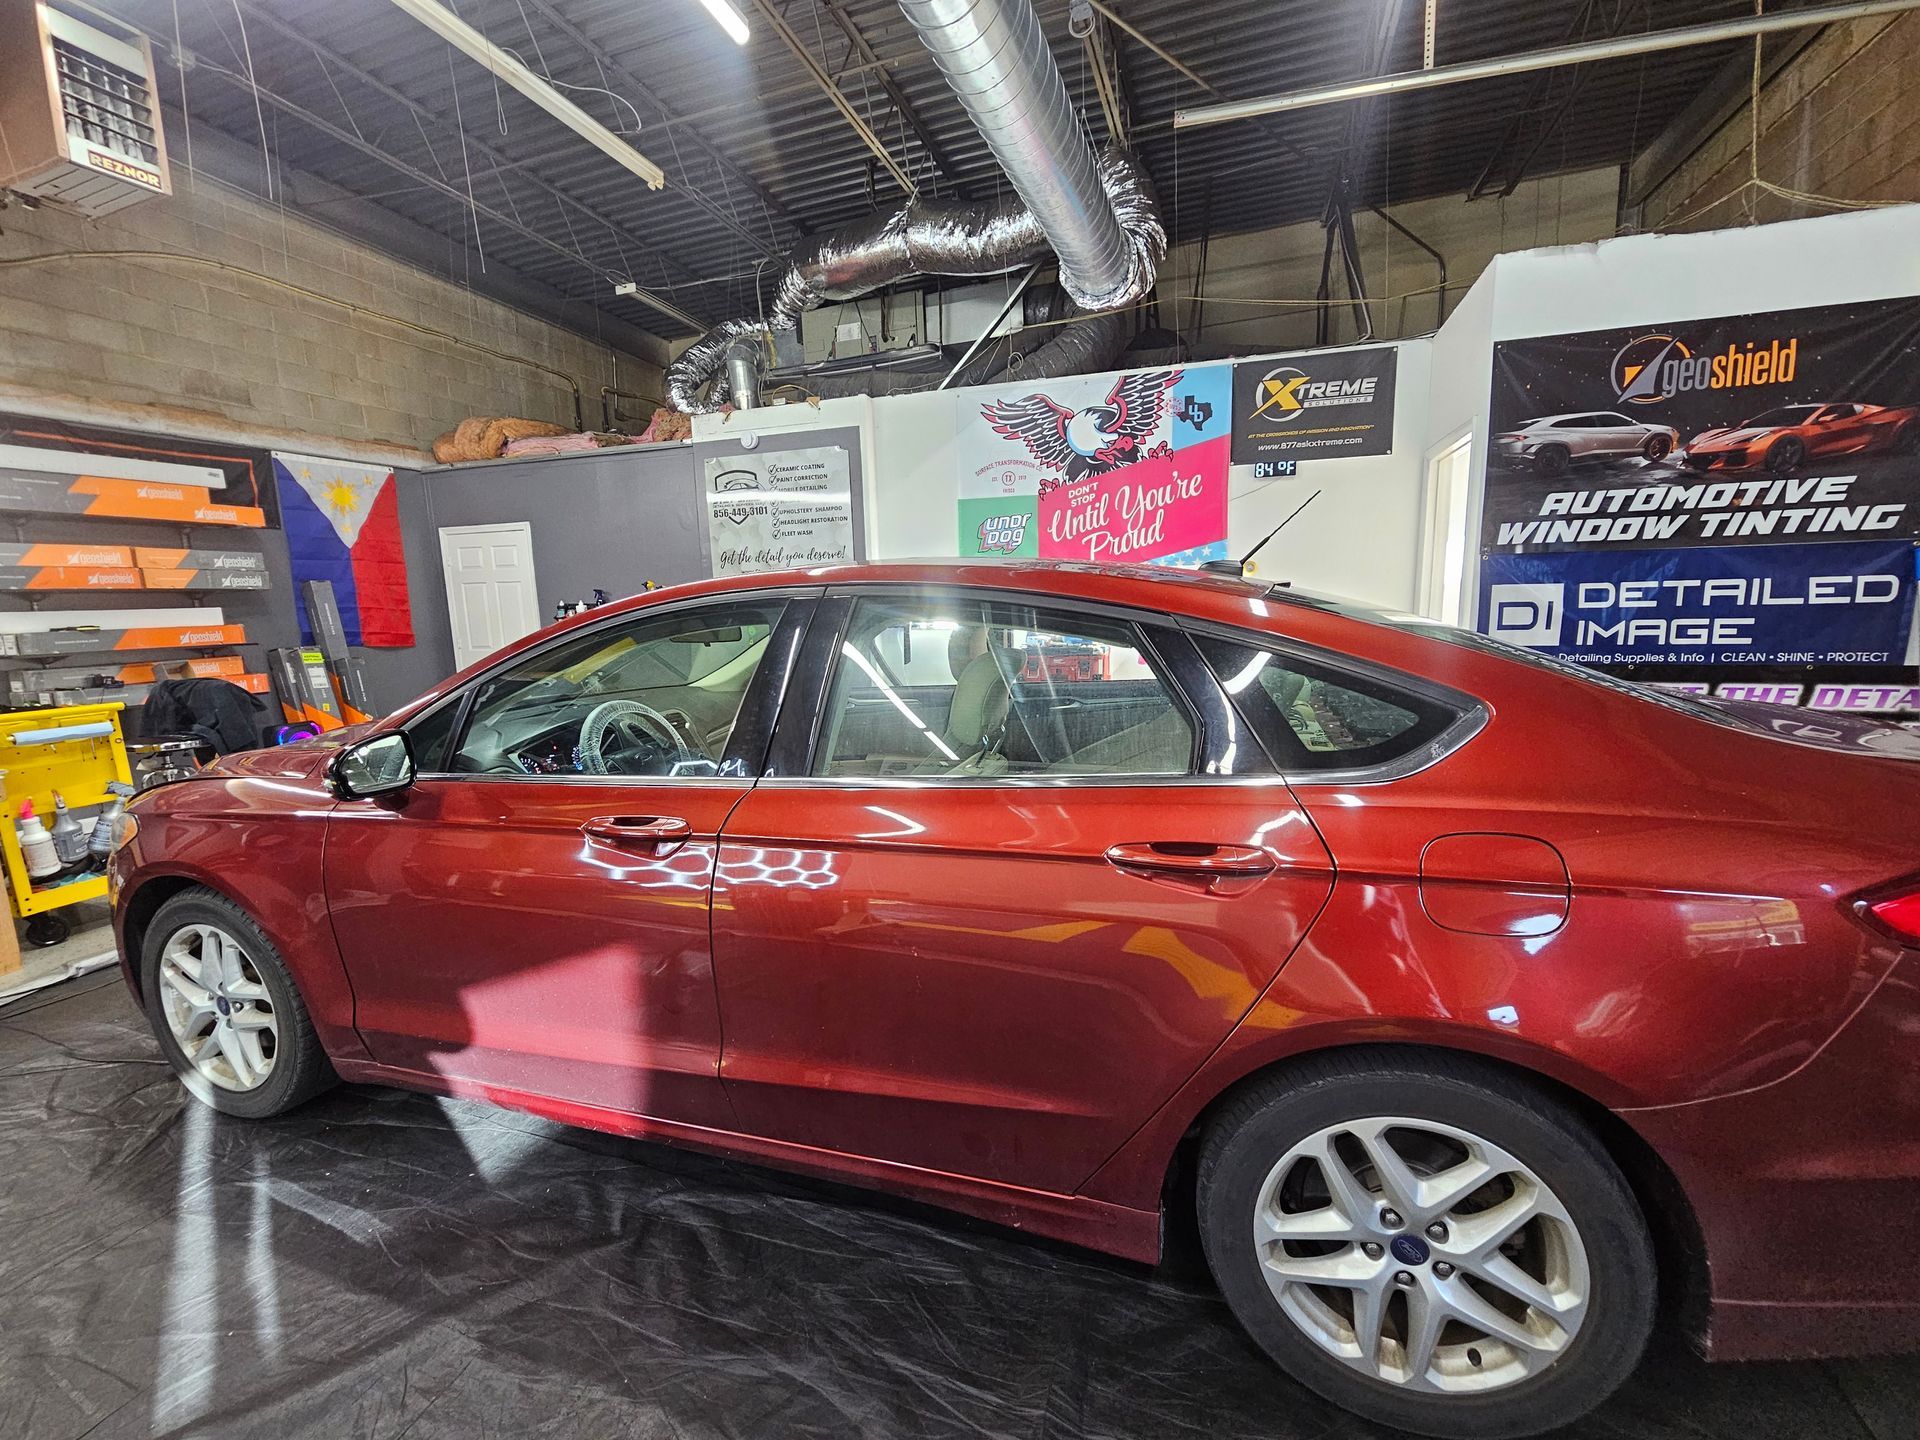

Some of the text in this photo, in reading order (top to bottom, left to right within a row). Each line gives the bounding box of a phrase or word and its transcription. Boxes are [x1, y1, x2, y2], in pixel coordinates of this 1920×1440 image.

[90, 152, 160, 186] REZNOR
[1661, 338, 1797, 398] geoshield
[1249, 376, 1378, 420] XTREME
[1308, 397, 1368, 406] SOLUTIONS
[775, 463, 825, 473] CERAMIC COATING
[975, 462, 994, 477] SURFACE
[994, 460, 1035, 469] TRANSFORMATION
[1255, 463, 1273, 477] 84
[1068, 482, 1099, 499] DON'T
[1071, 494, 1096, 507] STOP
[1538, 475, 1857, 516] AUTOMOTIVE
[713, 506, 768, 518] 856-449-3101
[779, 507, 812, 515] UPHOLSTERY
[1048, 471, 1203, 542] Until You're
[1082, 509, 1164, 560] Proud
[1496, 503, 1906, 545] WINDOW TINTING
[720, 545, 846, 569] Get the detail you deserve!
[1578, 574, 1899, 609] DETAILED
[1496, 600, 1554, 632] DI
[1576, 617, 1756, 646] IMAGE
[1559, 652, 1890, 664] Detailing Supplies & Info CLEAN SHINE PROTECT
[1721, 687, 1799, 705] THE
